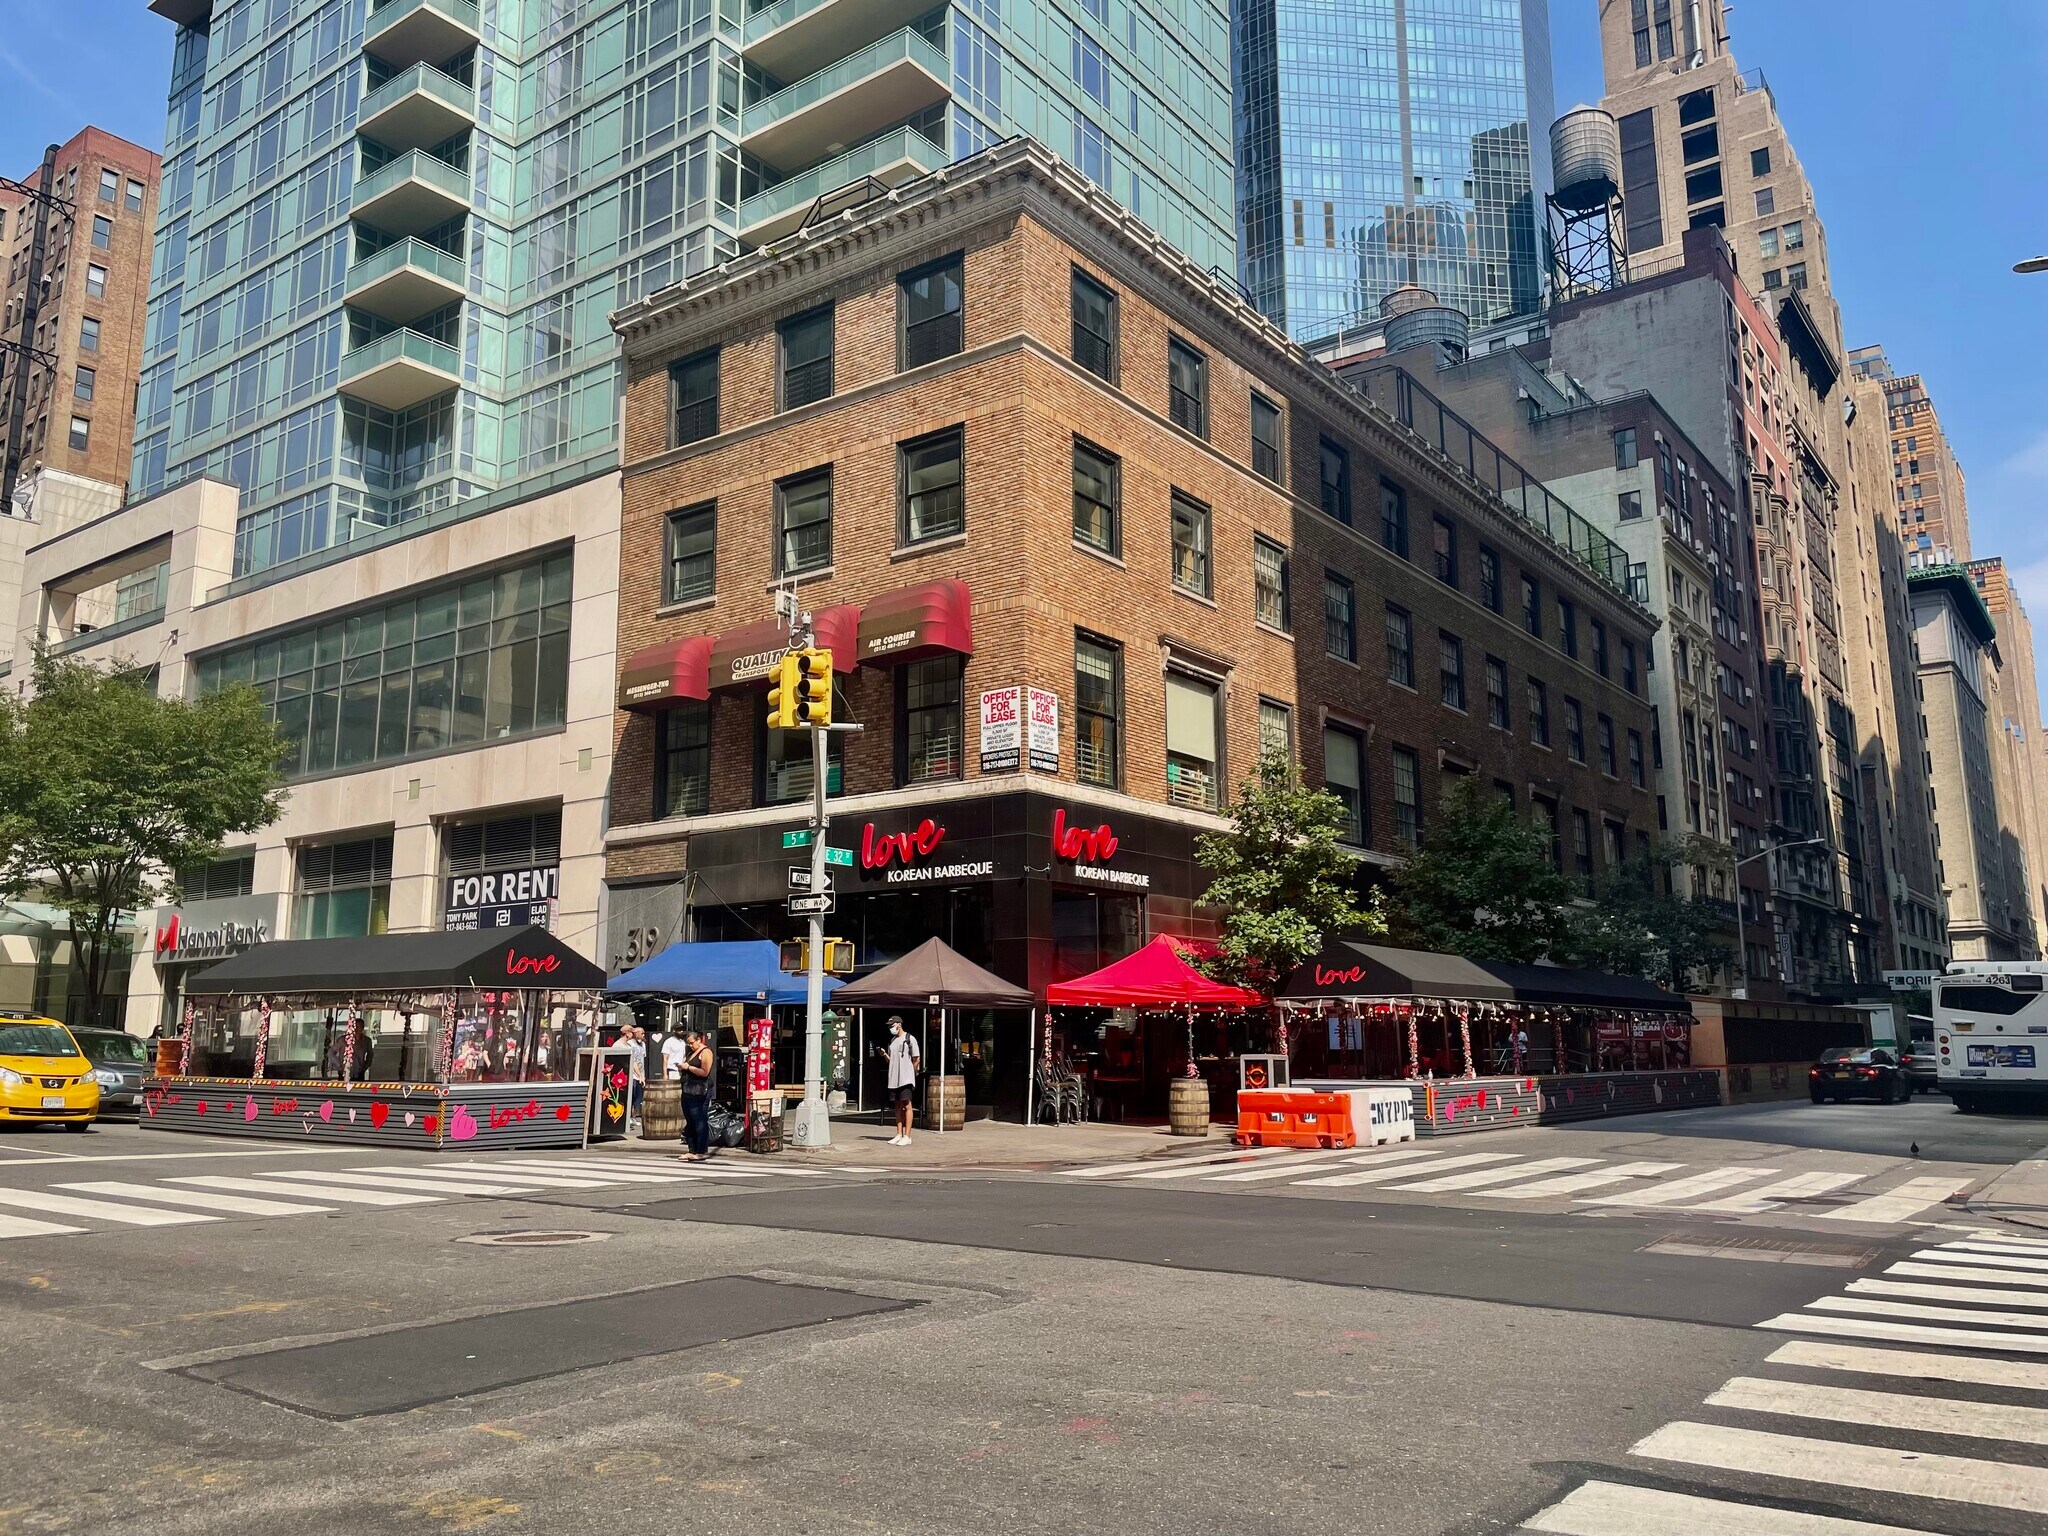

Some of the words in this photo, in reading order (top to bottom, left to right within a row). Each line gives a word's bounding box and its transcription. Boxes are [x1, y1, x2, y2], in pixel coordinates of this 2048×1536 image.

[868, 638, 882, 648] AIR
[883, 630, 916, 644] COURIER
[732, 647, 790, 672] QUALITY
[735, 666, 773, 678] TRANSPORTA
[983, 689, 1018, 704] OFFICE
[1030, 690, 1056, 706] OFFICE
[991, 701, 1010, 713] FOR
[1036, 702, 1050, 714] FOR
[986, 710, 1016, 724] LEASE
[1032, 711, 1054, 726] LEASE
[792, 834, 796, 845] 5
[1054, 808, 1118, 862] love
[861, 819, 945, 868] love
[826, 850, 830, 861] E
[834, 851, 843, 862] 32
[796, 874, 808, 882] ONE
[887, 867, 932, 882] KOREAN
[934, 862, 993, 878] BARBEQUE
[1076, 865, 1110, 880] KOREAN
[1110, 870, 1150, 887] BARBEQUE
[452, 876, 496, 906] FOR
[501, 868, 558, 902] RENT
[531, 906, 546, 914] ELAD
[794, 900, 808, 909] ONE
[446, 914, 462, 922] TONY
[462, 912, 478, 920] PARK
[531, 915, 546, 925] 646-8
[178, 923, 226, 950] Hanmi
[226, 919, 267, 945] Bank
[506, 949, 560, 974] love
[1316, 964, 1366, 986] love
[1986, 976, 2010, 984] 4263
[273, 1096, 298, 1115] love
[1376, 1100, 1409, 1124] NYPD
[490, 1098, 542, 1129] love
